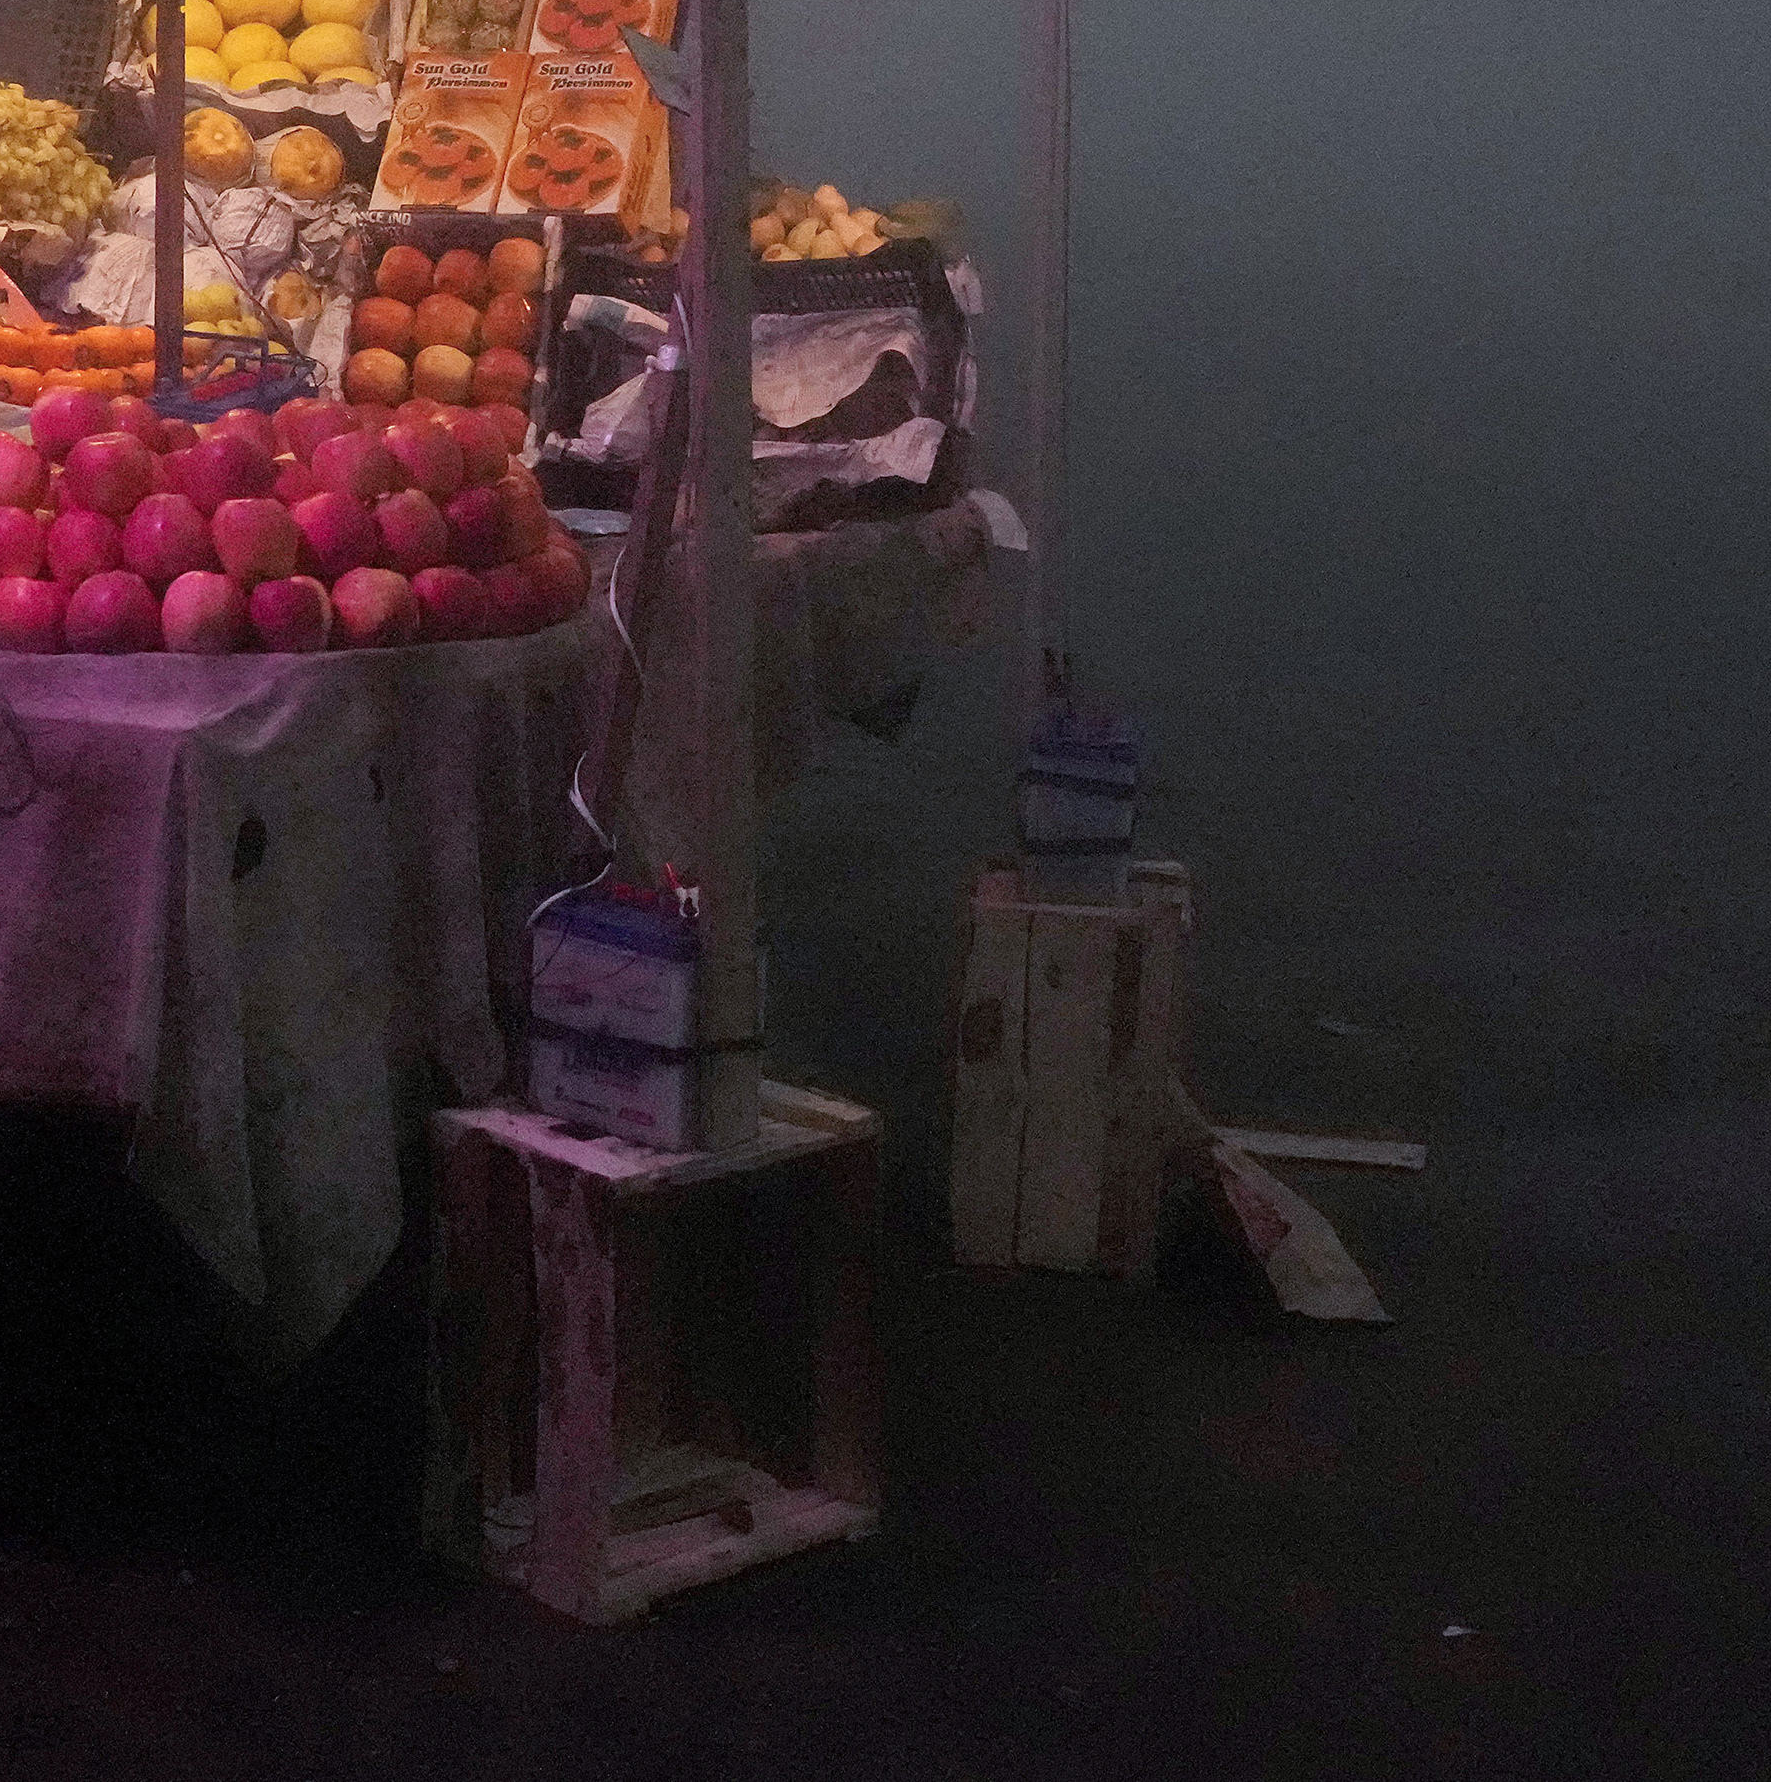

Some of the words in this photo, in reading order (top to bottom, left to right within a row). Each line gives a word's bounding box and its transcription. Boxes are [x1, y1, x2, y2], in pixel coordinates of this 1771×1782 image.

[413, 62, 445, 75] Sun
[449, 62, 489, 75] Gold
[538, 62, 570, 76] Sun
[574, 62, 614, 75] Gold
[425, 76, 509, 90] Persimmon
[550, 77, 634, 91] Persimmon
